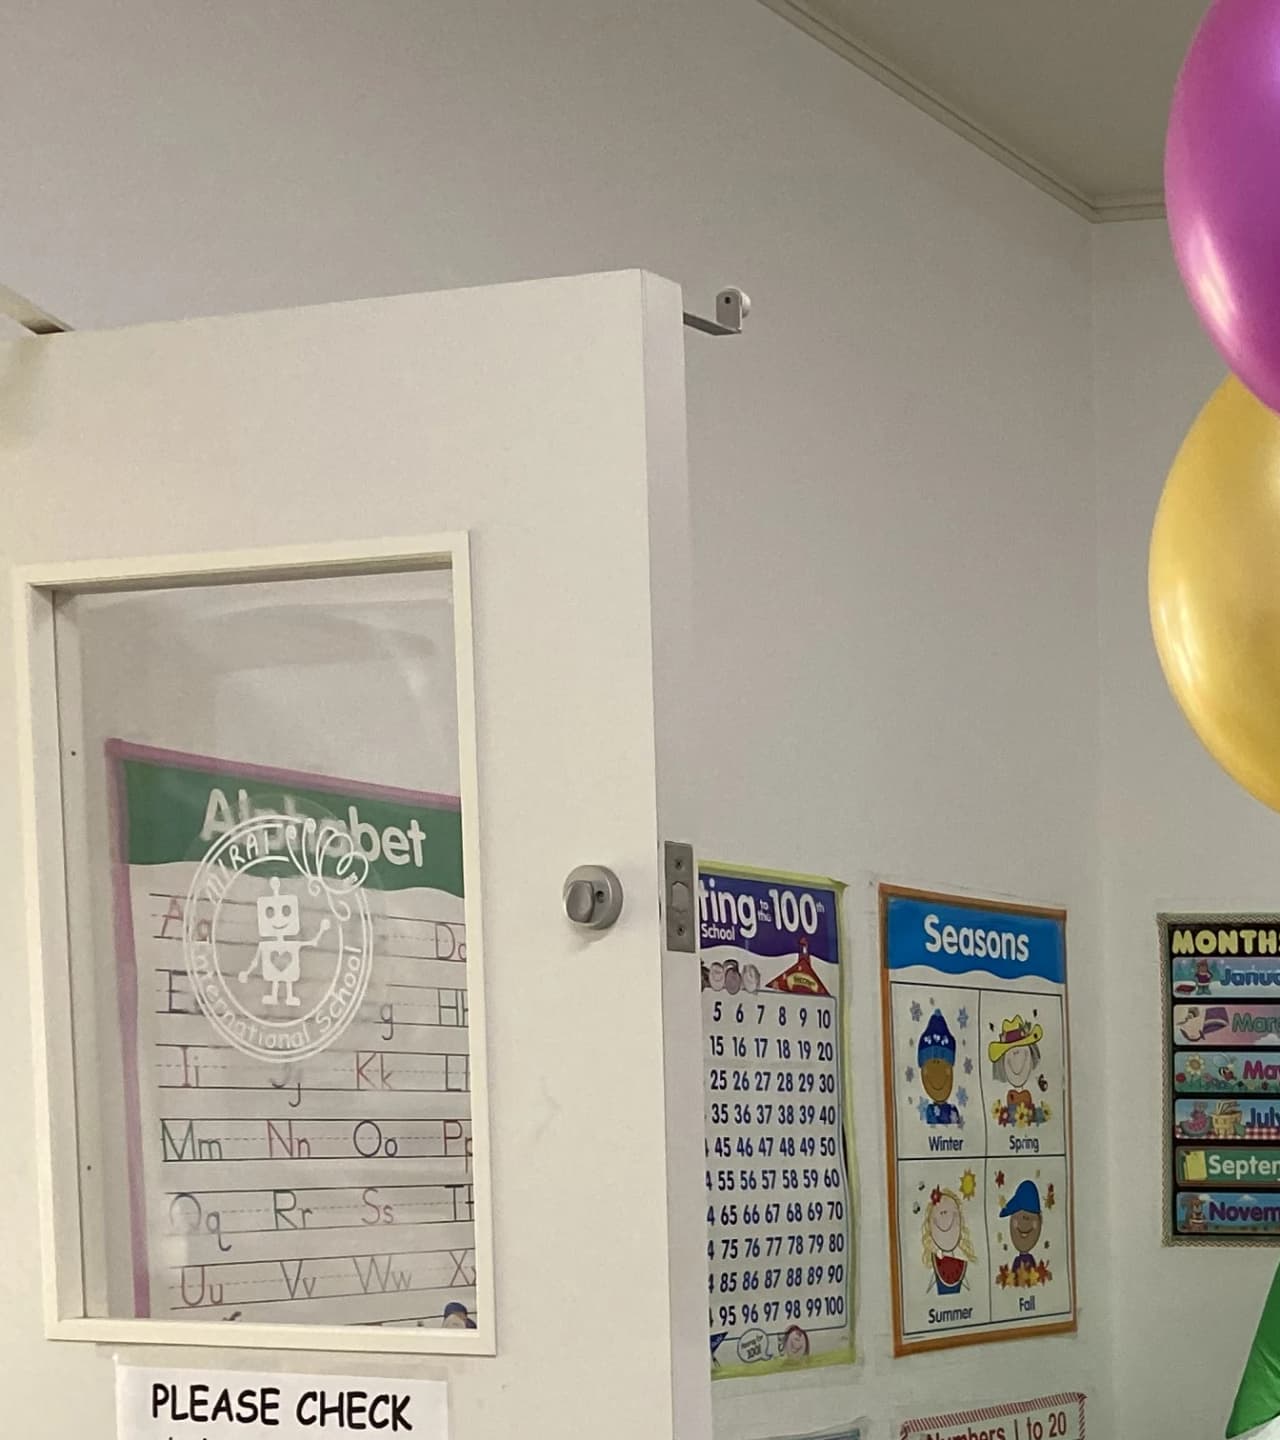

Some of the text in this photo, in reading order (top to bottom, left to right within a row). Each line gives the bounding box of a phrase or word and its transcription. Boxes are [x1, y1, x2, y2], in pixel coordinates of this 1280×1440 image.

[702, 923, 735, 940] School
[924, 914, 1029, 962] Seasons
[315, 946, 362, 1033] School
[710, 1070, 834, 1093] 25 26 27 28 29 30
[161, 1120, 223, 1160] Mm
[266, 1120, 311, 1159] Nn
[353, 1120, 398, 1158] Oo
[928, 1136, 964, 1151] Winter
[1009, 1135, 1039, 1153] Spring
[272, 1189, 313, 1230] Rr
[928, 1307, 973, 1323] Summer
[1019, 1297, 1035, 1311] Fall
[151, 1383, 413, 1431] PLEASE CHECK
[1048, 1411, 1066, 1438] 20
